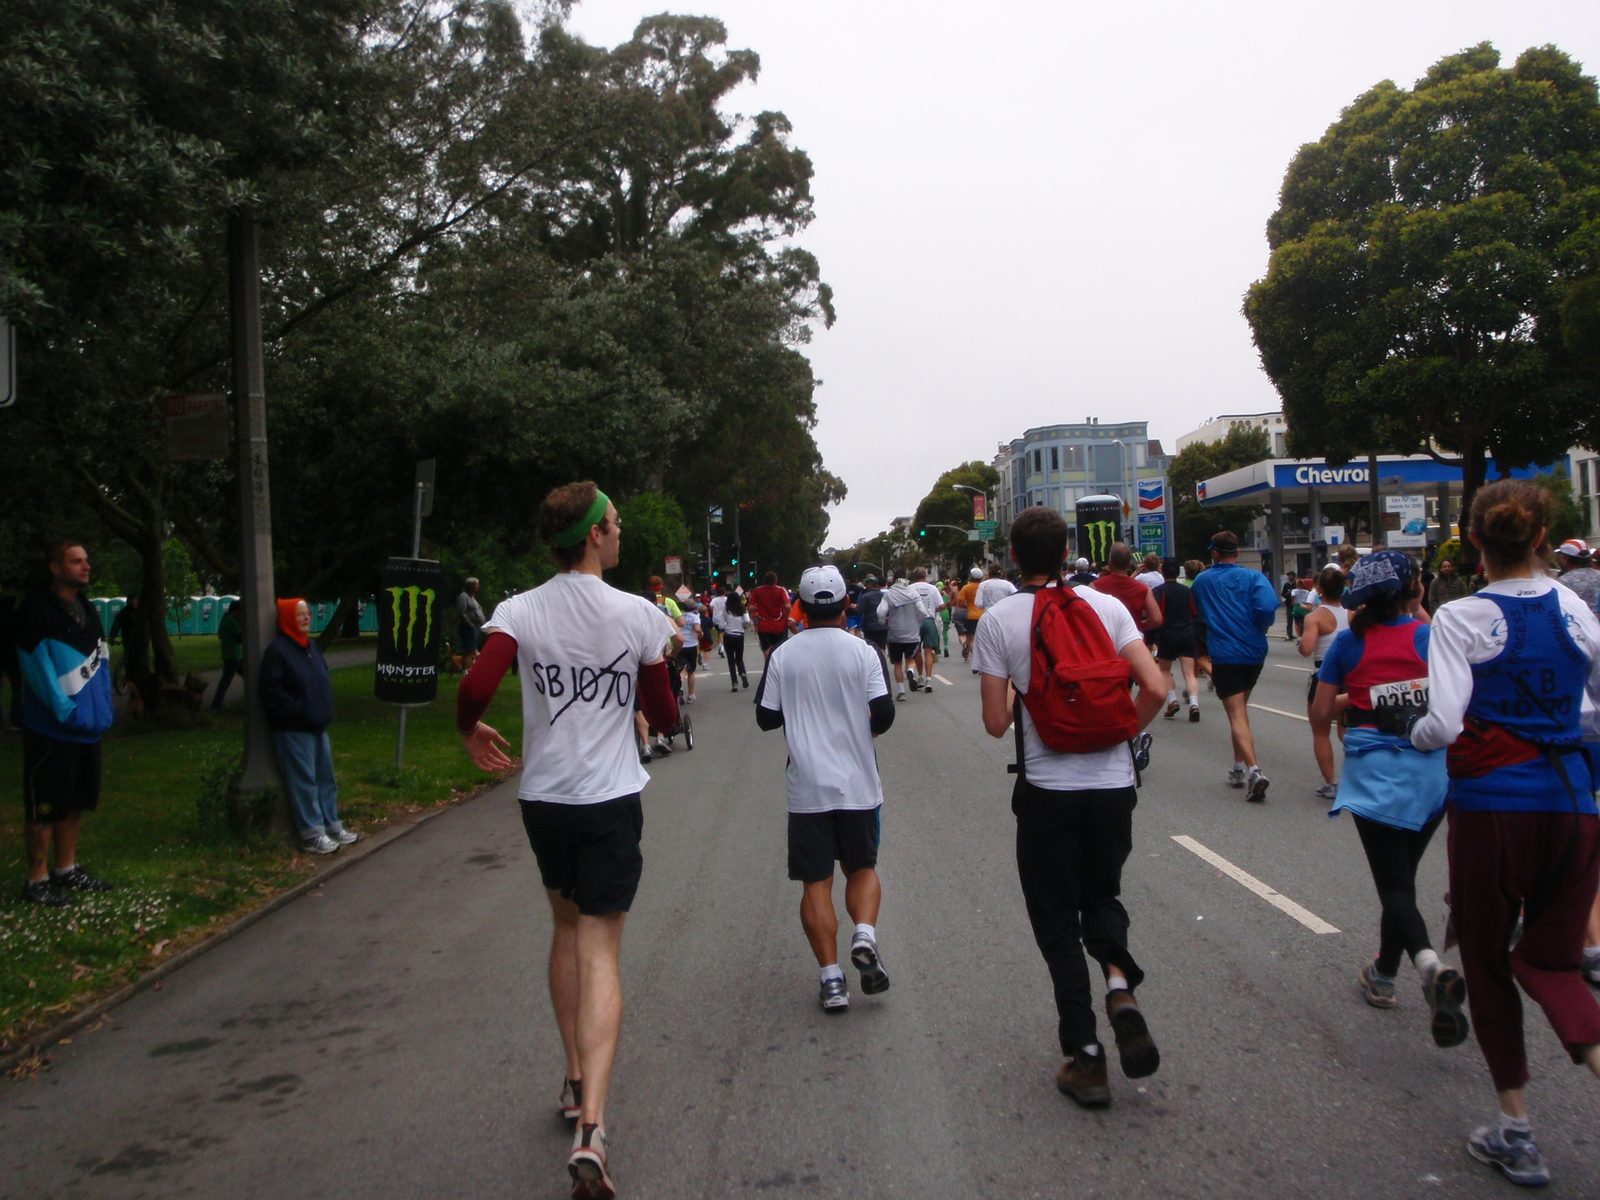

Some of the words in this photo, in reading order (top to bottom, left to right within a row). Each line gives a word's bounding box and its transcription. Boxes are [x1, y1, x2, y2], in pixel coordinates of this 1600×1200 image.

[377, 664, 435, 678] MONSTER
[533, 662, 564, 698] SB
[571, 666, 631, 709] 1070
[1386, 683, 1408, 694] ING
